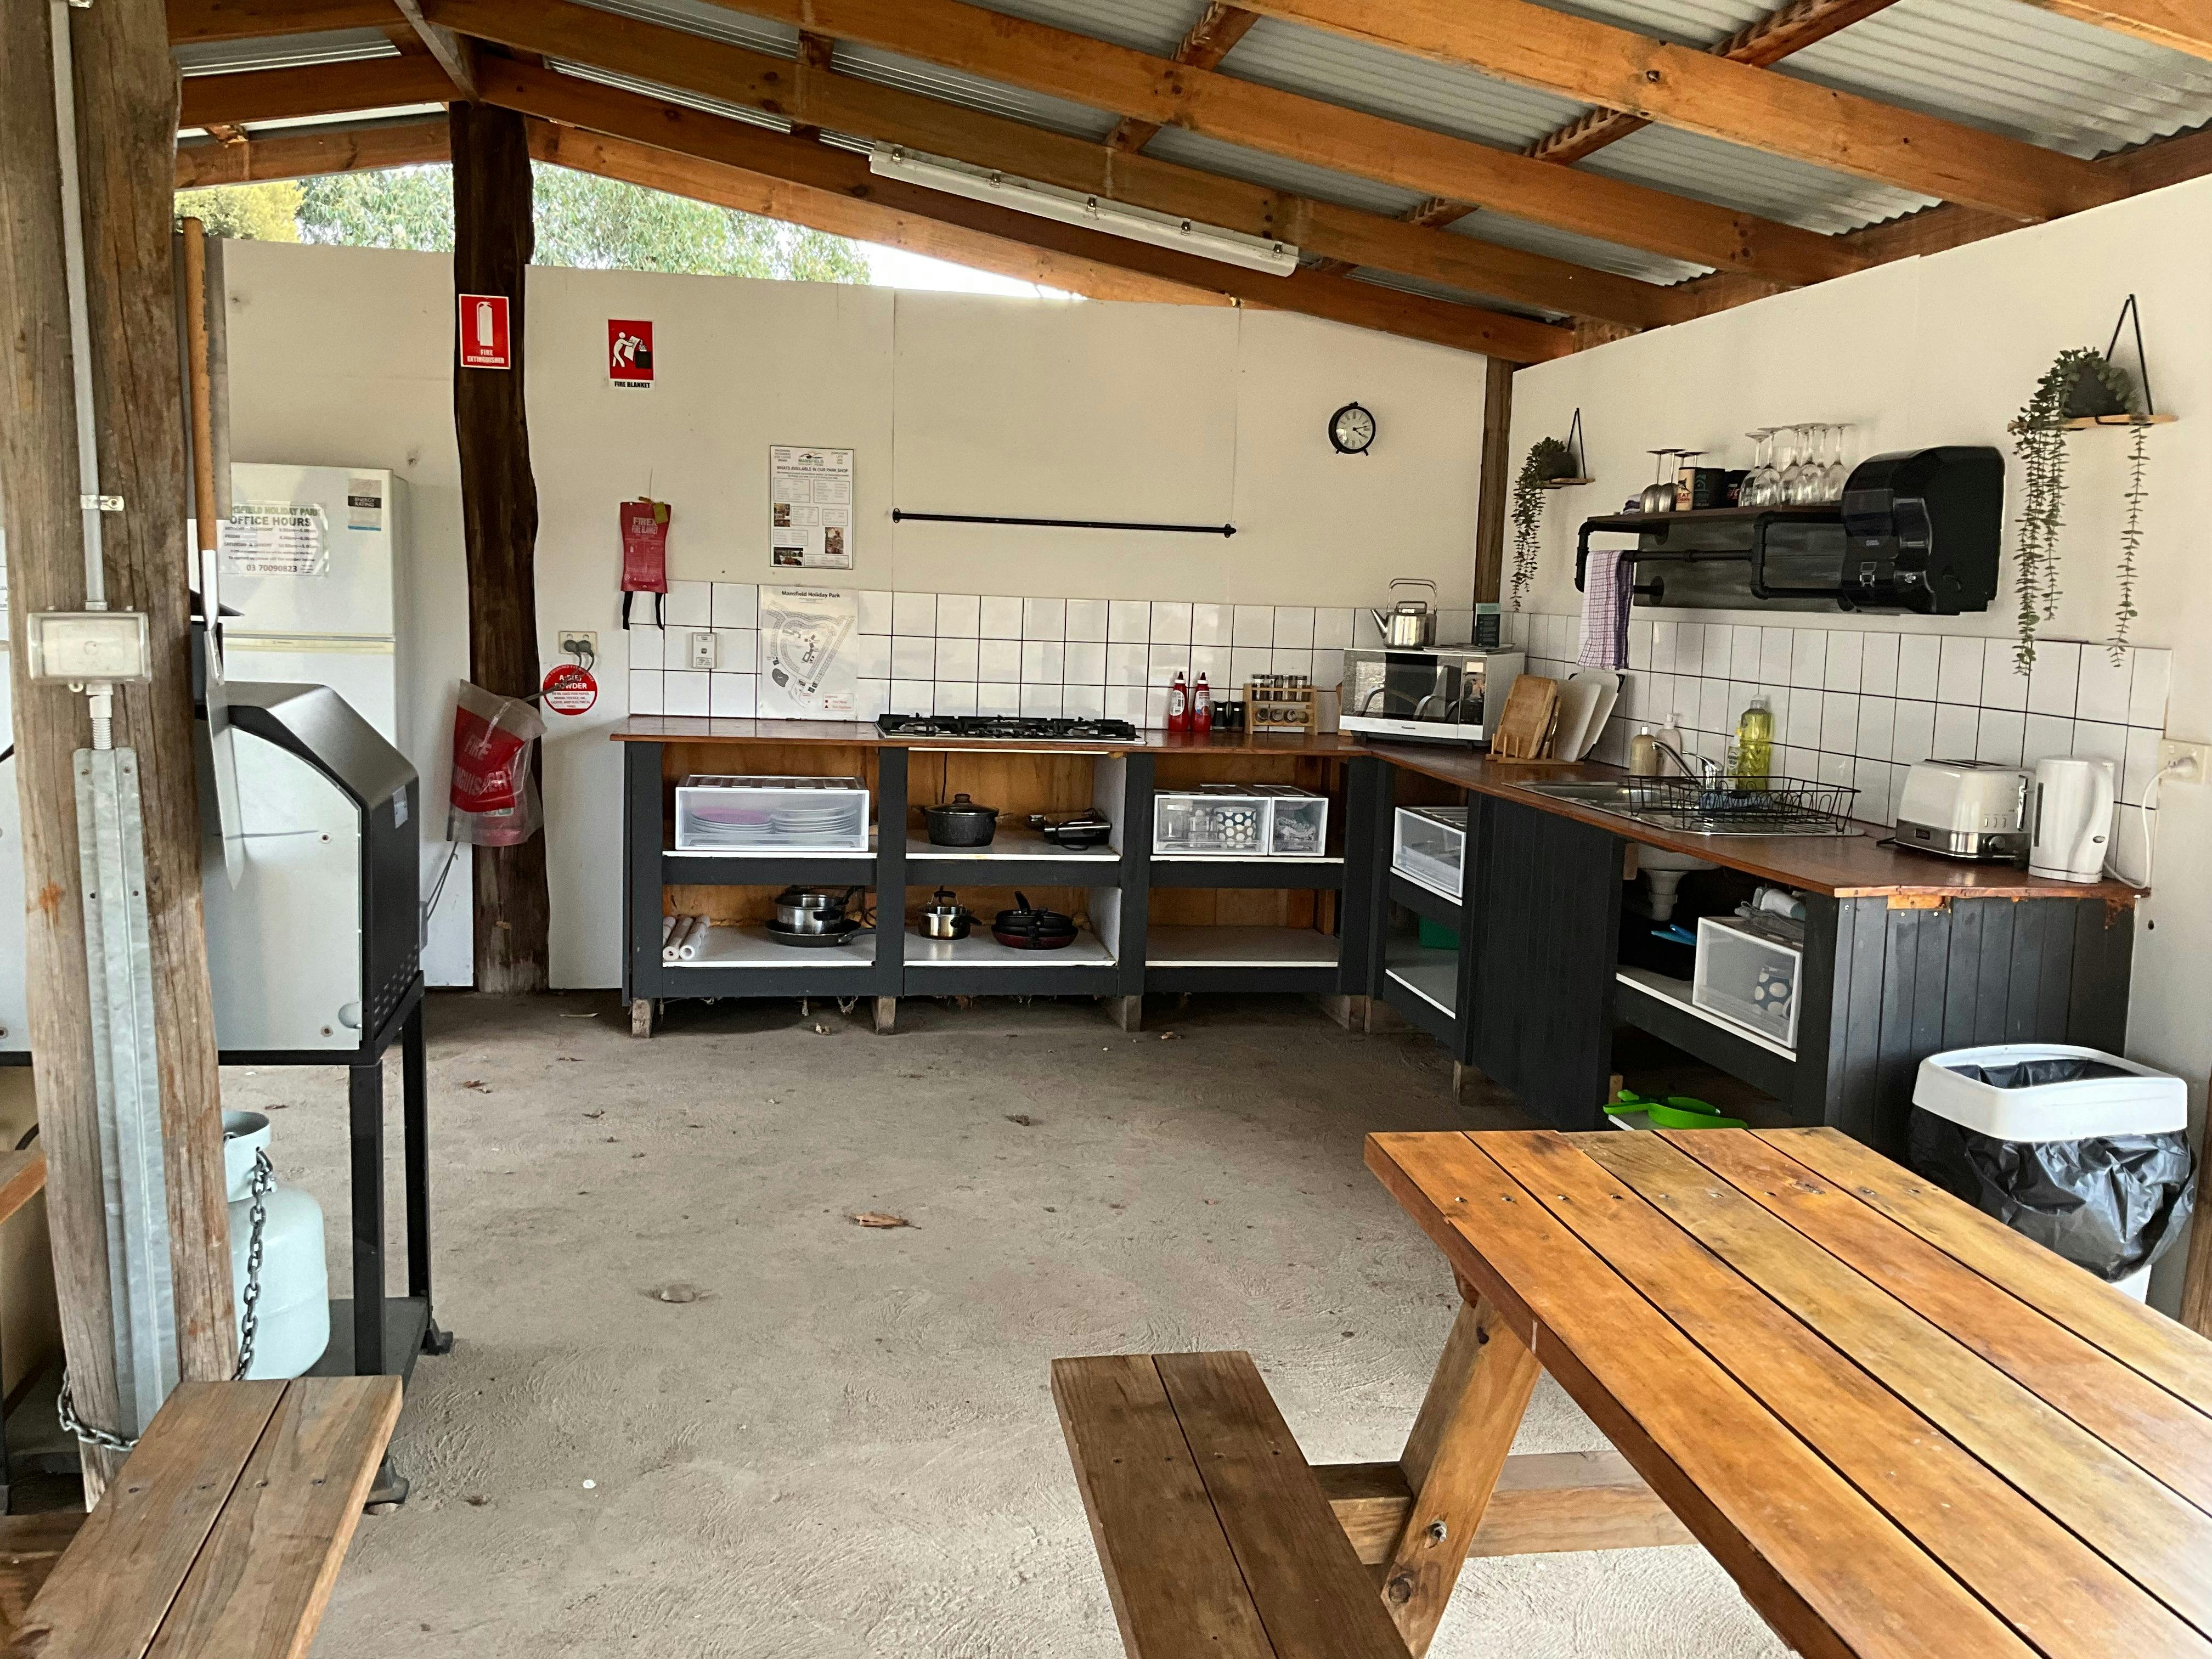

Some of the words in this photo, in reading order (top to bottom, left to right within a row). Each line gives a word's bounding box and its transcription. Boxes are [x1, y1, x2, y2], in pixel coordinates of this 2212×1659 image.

[467, 356, 505, 364] EXTINGUISHER
[265, 506, 298, 515] HOLIDAY
[230, 516, 269, 525] OFFICE
[272, 517, 311, 527] HOURS
